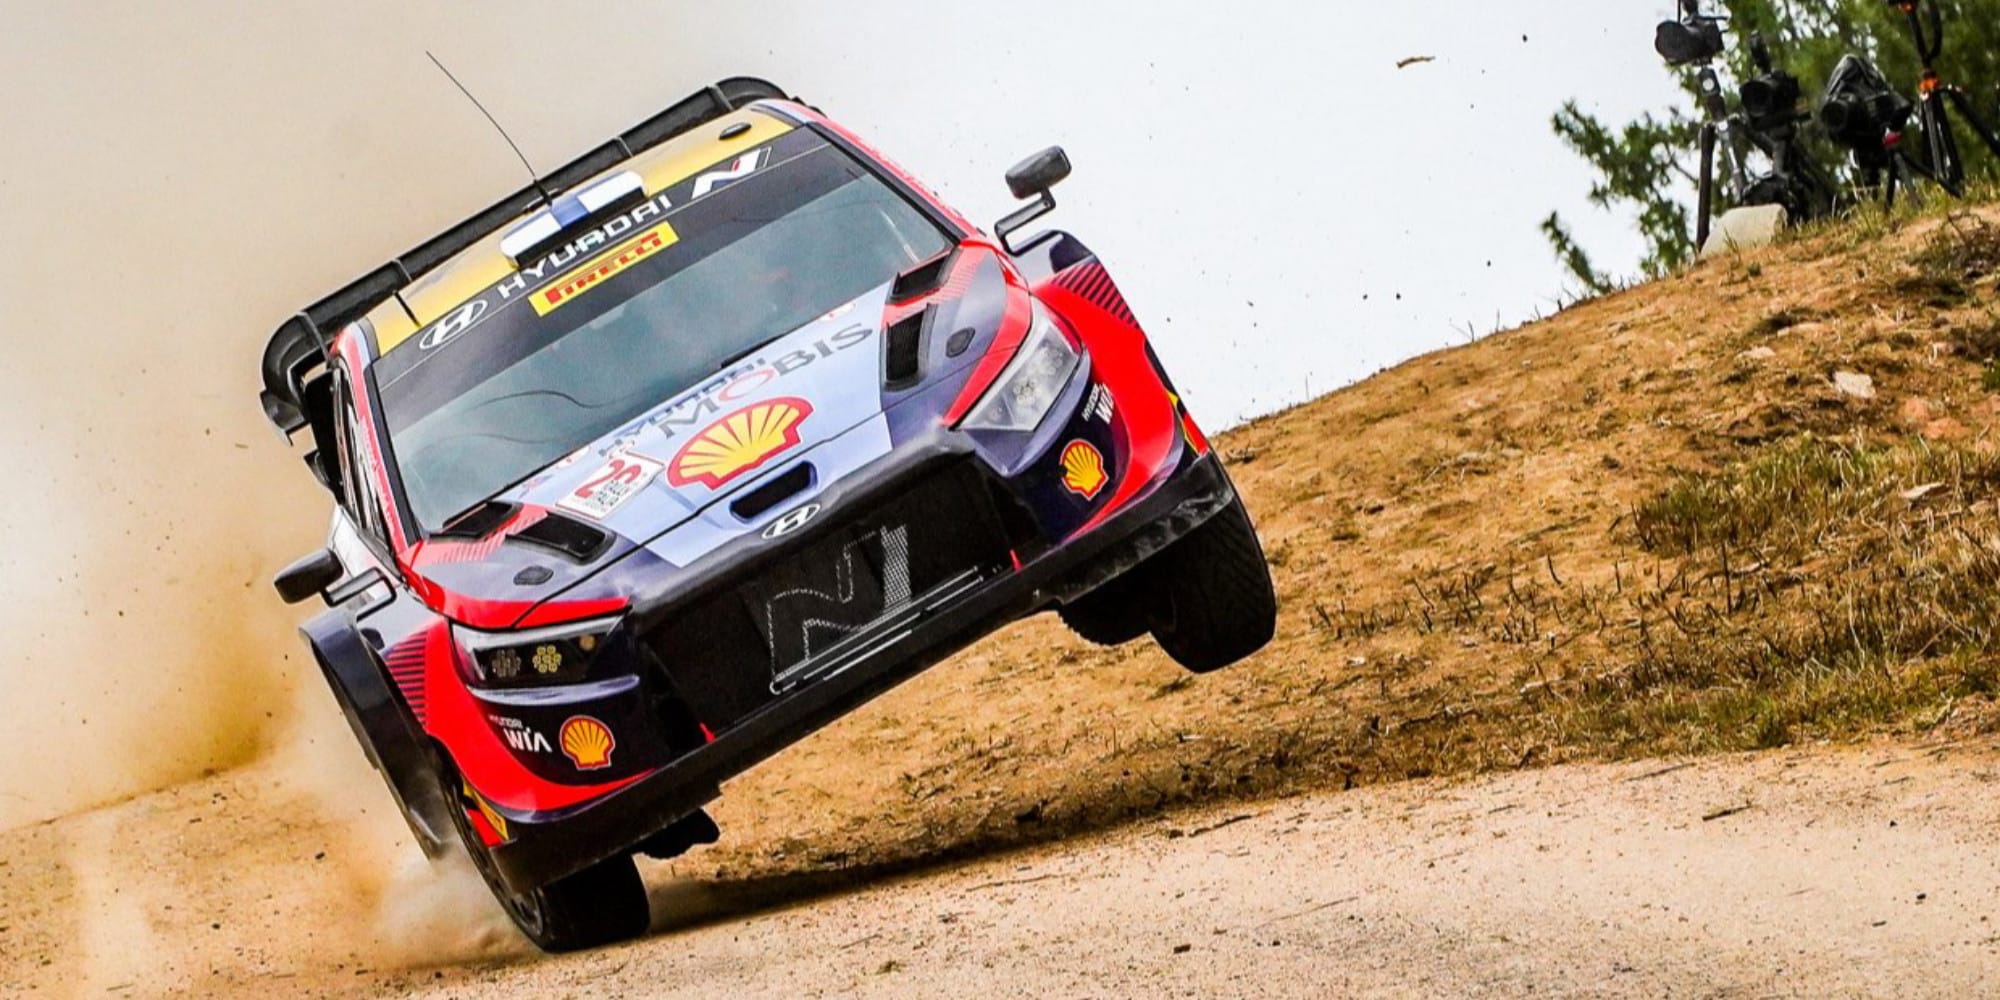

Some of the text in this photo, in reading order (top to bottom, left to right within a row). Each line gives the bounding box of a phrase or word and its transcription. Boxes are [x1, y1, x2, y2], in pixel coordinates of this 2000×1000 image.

[497, 194, 673, 299] HYUNDAI
[544, 231, 663, 305] PIRELLI
[657, 322, 874, 440] MOBIS
